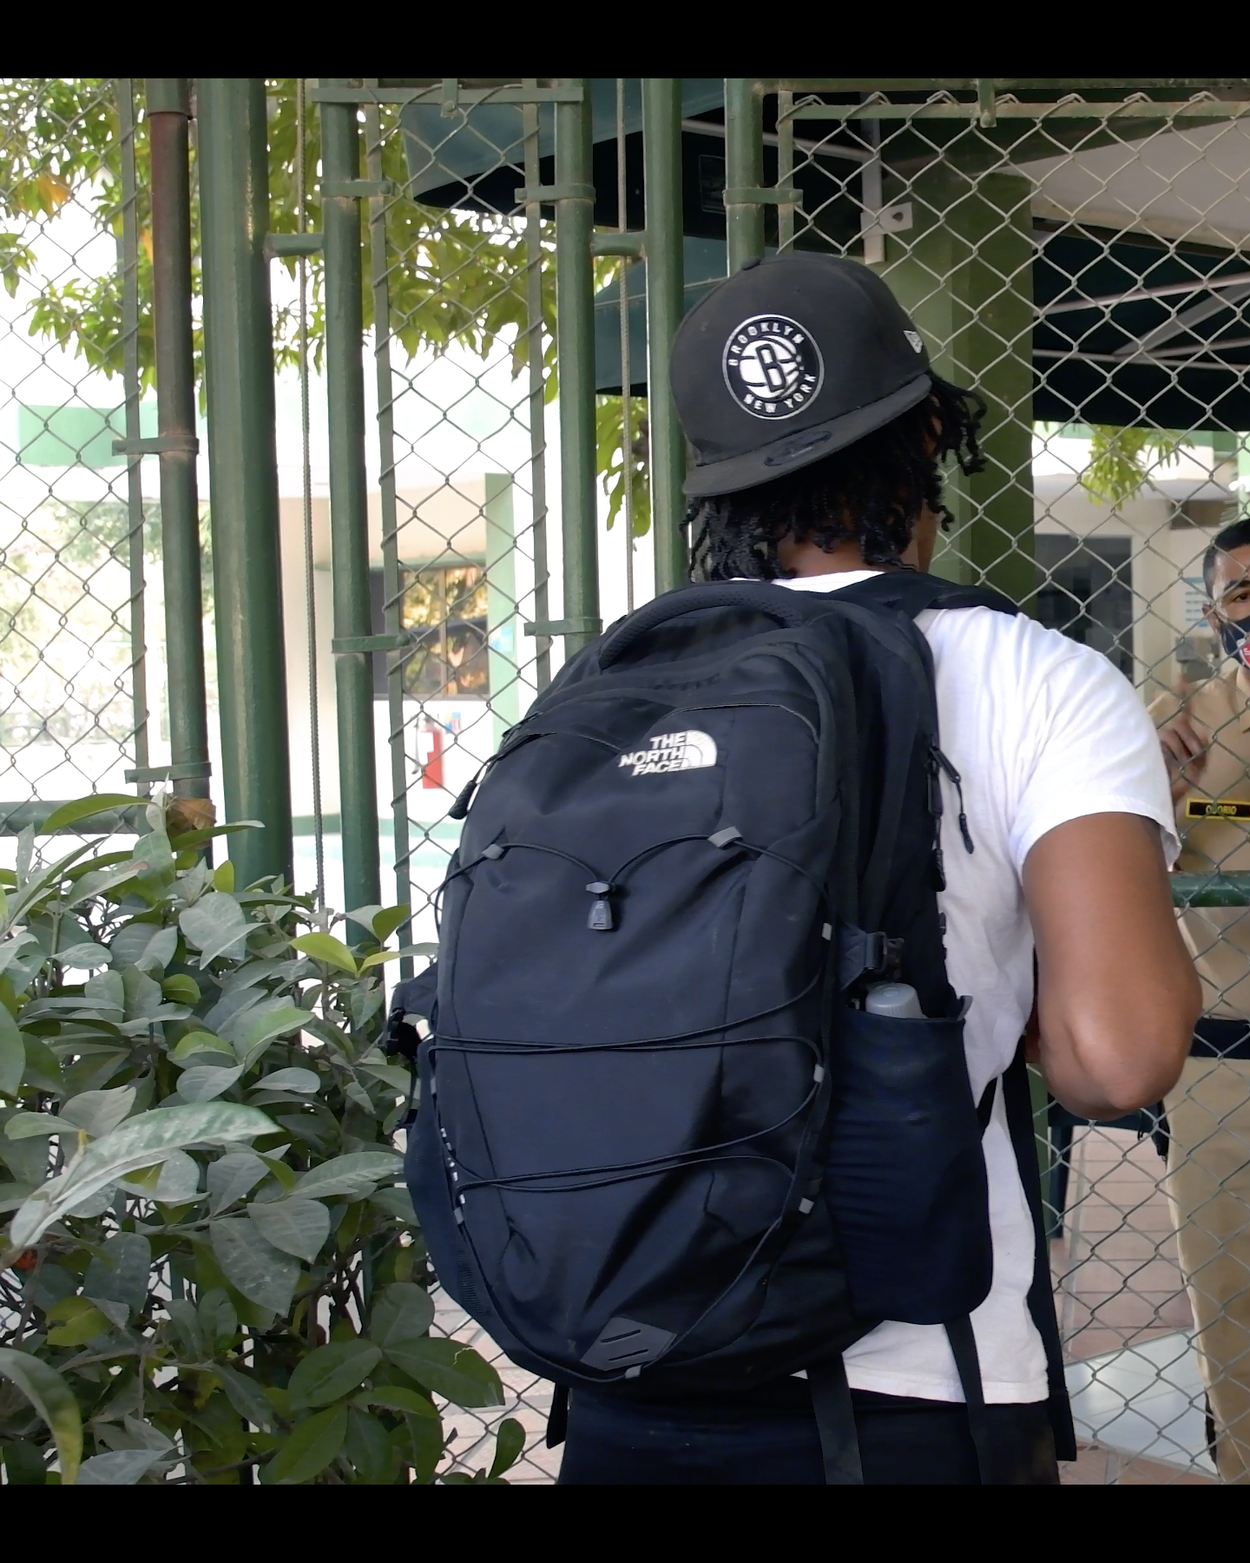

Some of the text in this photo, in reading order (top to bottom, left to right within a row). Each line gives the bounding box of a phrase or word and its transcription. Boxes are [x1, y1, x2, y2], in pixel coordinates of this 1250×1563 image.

[728, 322, 805, 366] BROOKLYN
[743, 374, 816, 413] NEW YORK
[650, 732, 686, 749] THE
[618, 746, 684, 767] NORTH
[631, 759, 684, 776] FACE
